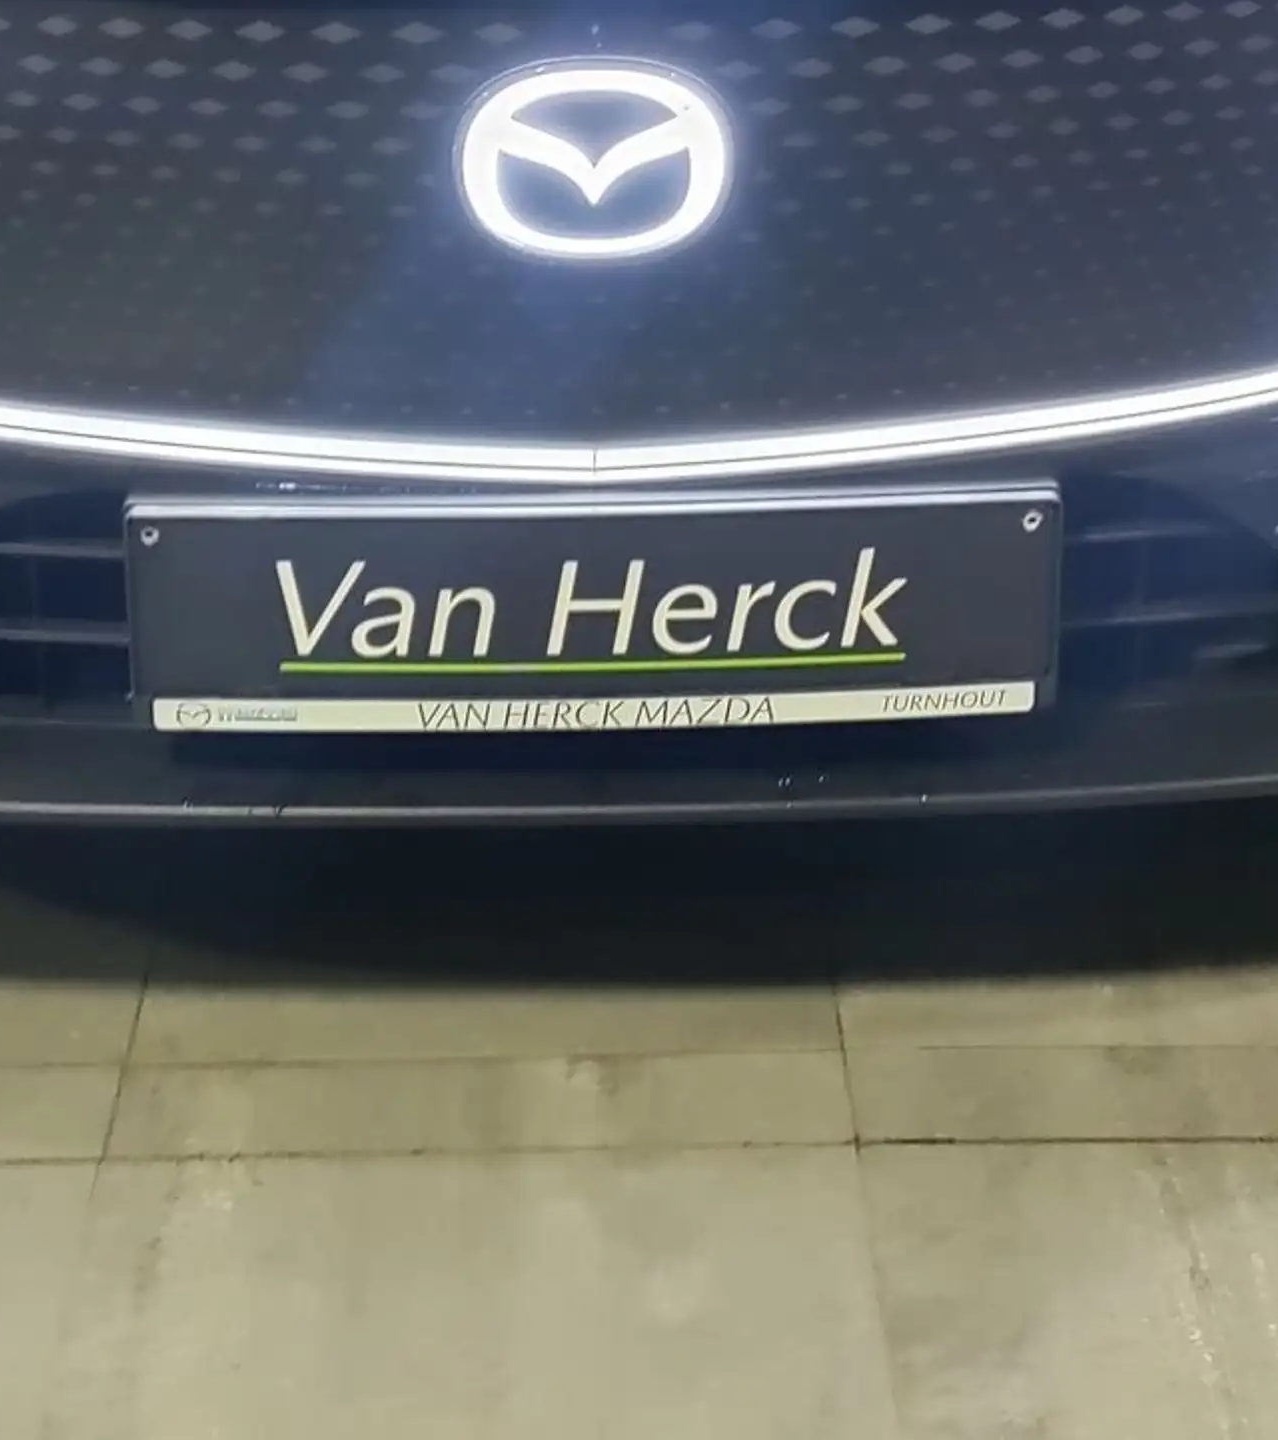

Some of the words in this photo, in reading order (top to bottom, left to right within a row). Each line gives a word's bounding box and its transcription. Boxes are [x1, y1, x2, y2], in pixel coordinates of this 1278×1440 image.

[275, 559, 495, 658] Van
[546, 546, 907, 656] Herck
[418, 702, 491, 730] VAN
[504, 701, 625, 730] HERCK
[634, 697, 775, 728] MAZDA
[881, 689, 1007, 713] TURNHOUT
